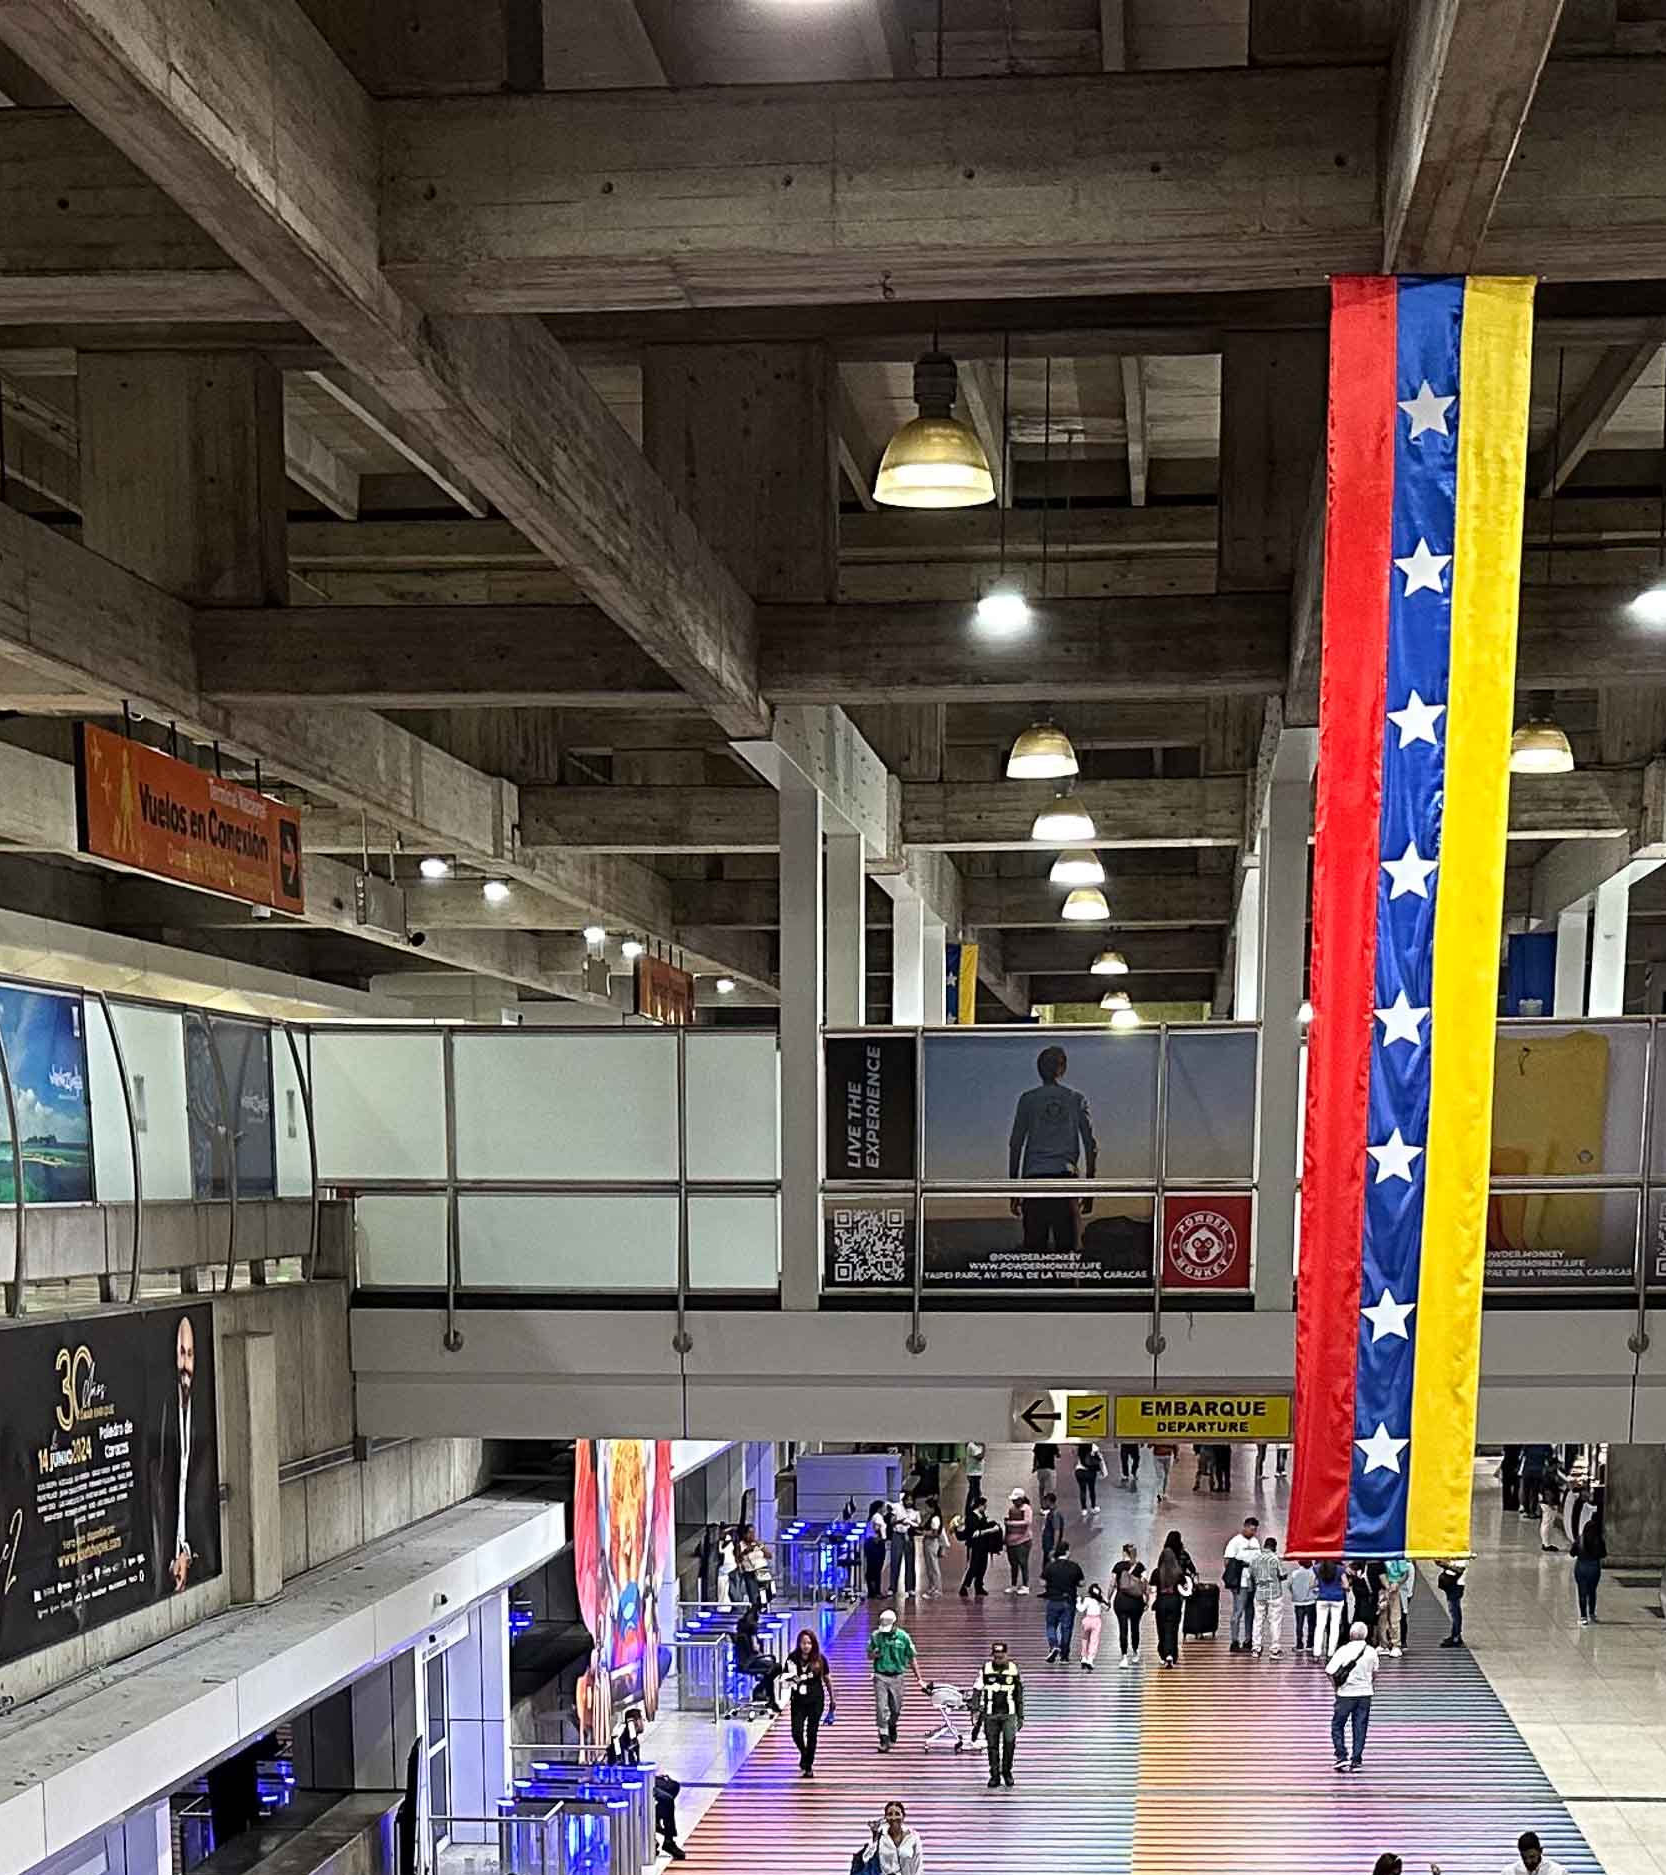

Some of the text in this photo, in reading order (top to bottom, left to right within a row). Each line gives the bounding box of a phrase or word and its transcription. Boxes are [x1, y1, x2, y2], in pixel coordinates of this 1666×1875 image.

[139, 783, 187, 836] Vuelos
[190, 809, 206, 841] en
[866, 1045, 881, 1168] EXPERIENCE
[847, 1081, 862, 1168] LIVE THE
[1026, 1271, 1039, 1280] DE
[1040, 1271, 1053, 1280] LA
[1103, 1271, 1148, 1280] CARACAS
[1522, 1268, 1535, 1277] LA
[1140, 1401, 1266, 1417] EMBARQUE
[1157, 1421, 1249, 1433] DEPARTURE
